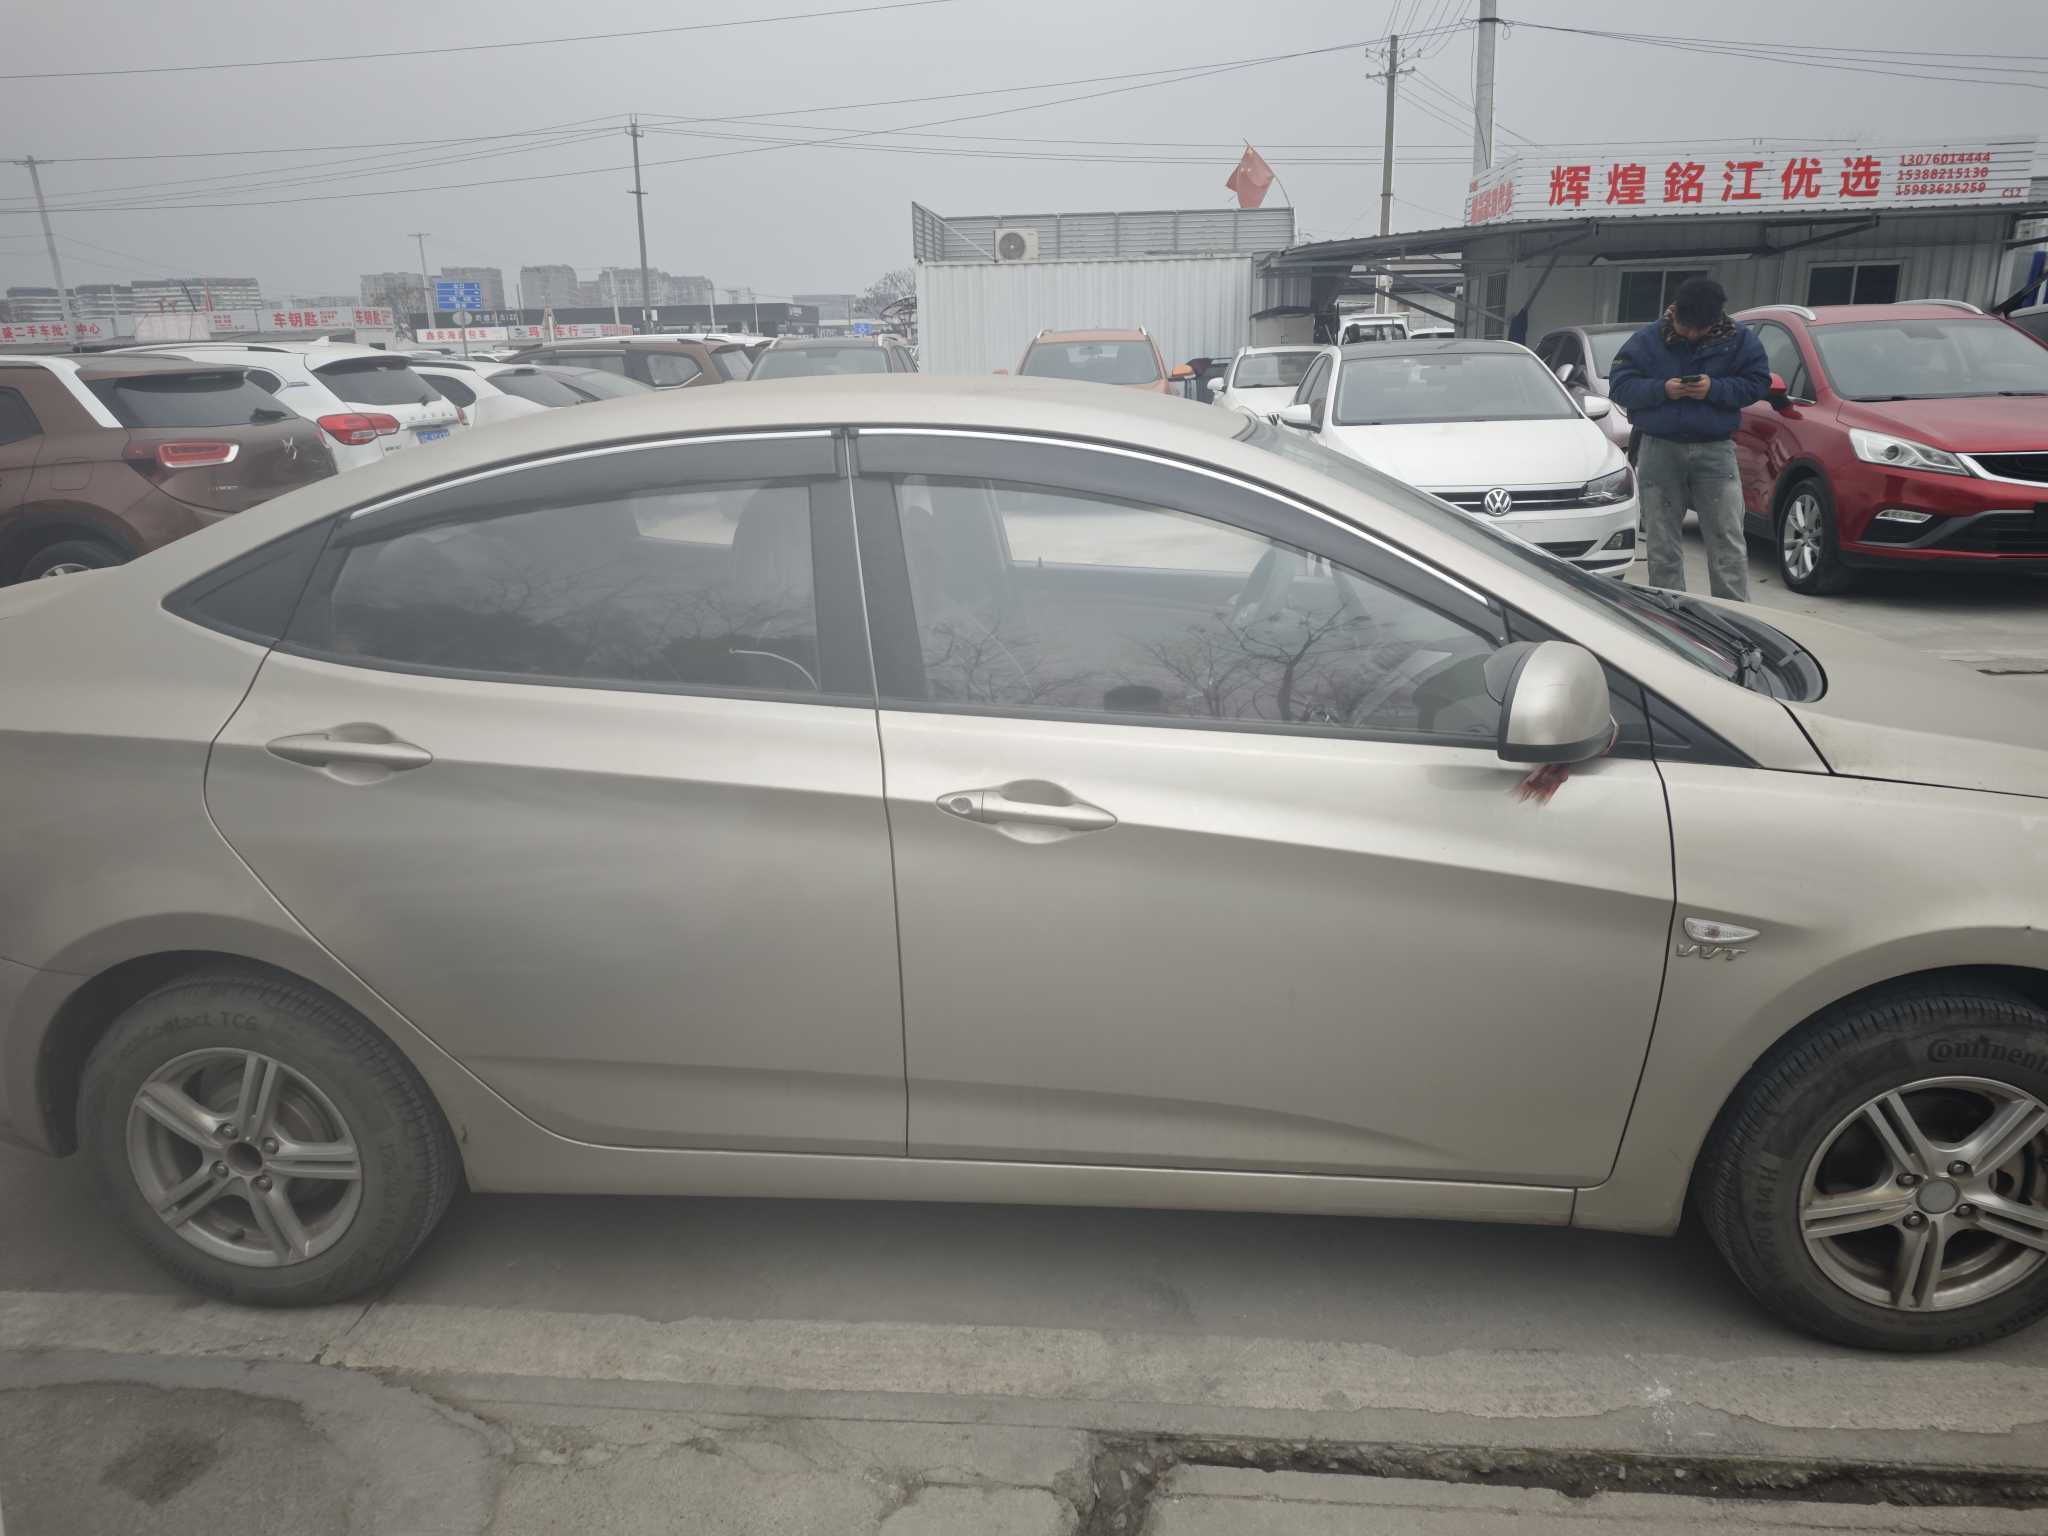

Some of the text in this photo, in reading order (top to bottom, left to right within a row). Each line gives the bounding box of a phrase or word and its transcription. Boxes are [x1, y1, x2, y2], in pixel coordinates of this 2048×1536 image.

[1899, 152, 1991, 166] 13076014444
[1549, 156, 1882, 208] 辉煌銘江优选
[273, 312, 319, 329] 车钥匙
